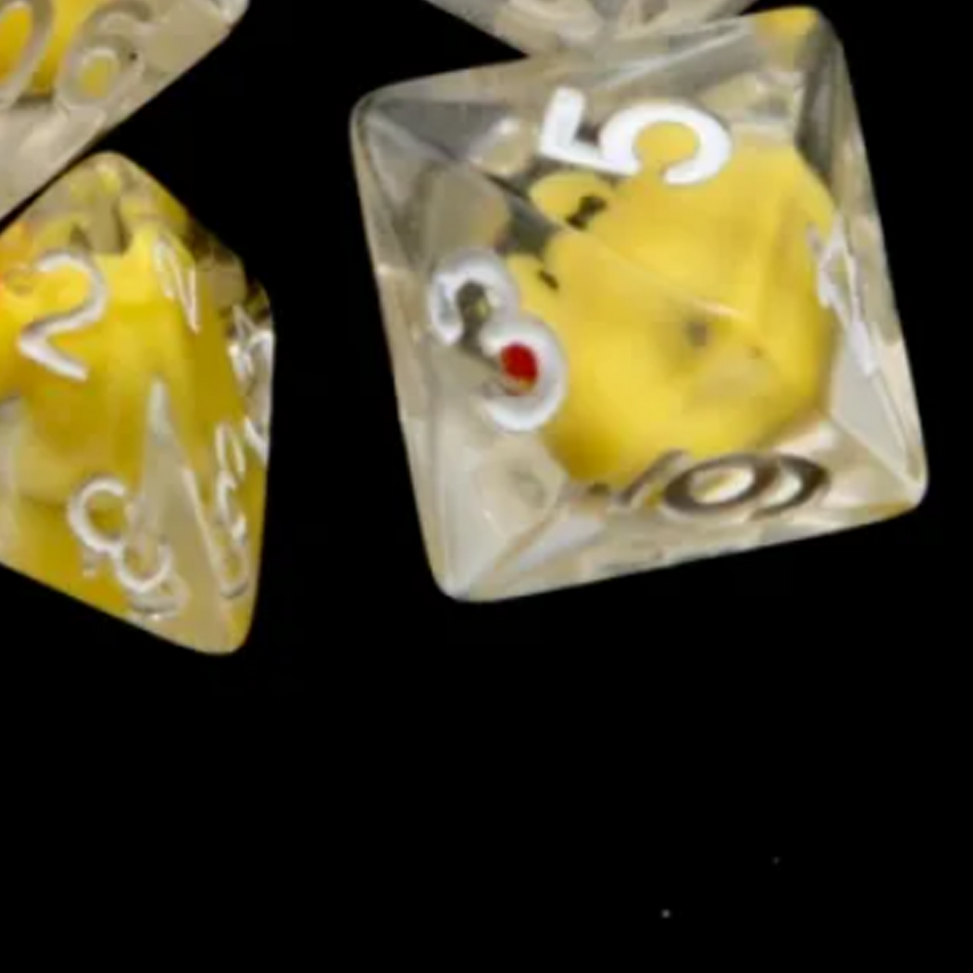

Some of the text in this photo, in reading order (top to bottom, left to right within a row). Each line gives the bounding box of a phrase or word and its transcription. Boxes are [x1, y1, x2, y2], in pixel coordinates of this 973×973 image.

[538, 85, 732, 186] 5
[16, 249, 110, 381] 2
[427, 249, 568, 433] 3
